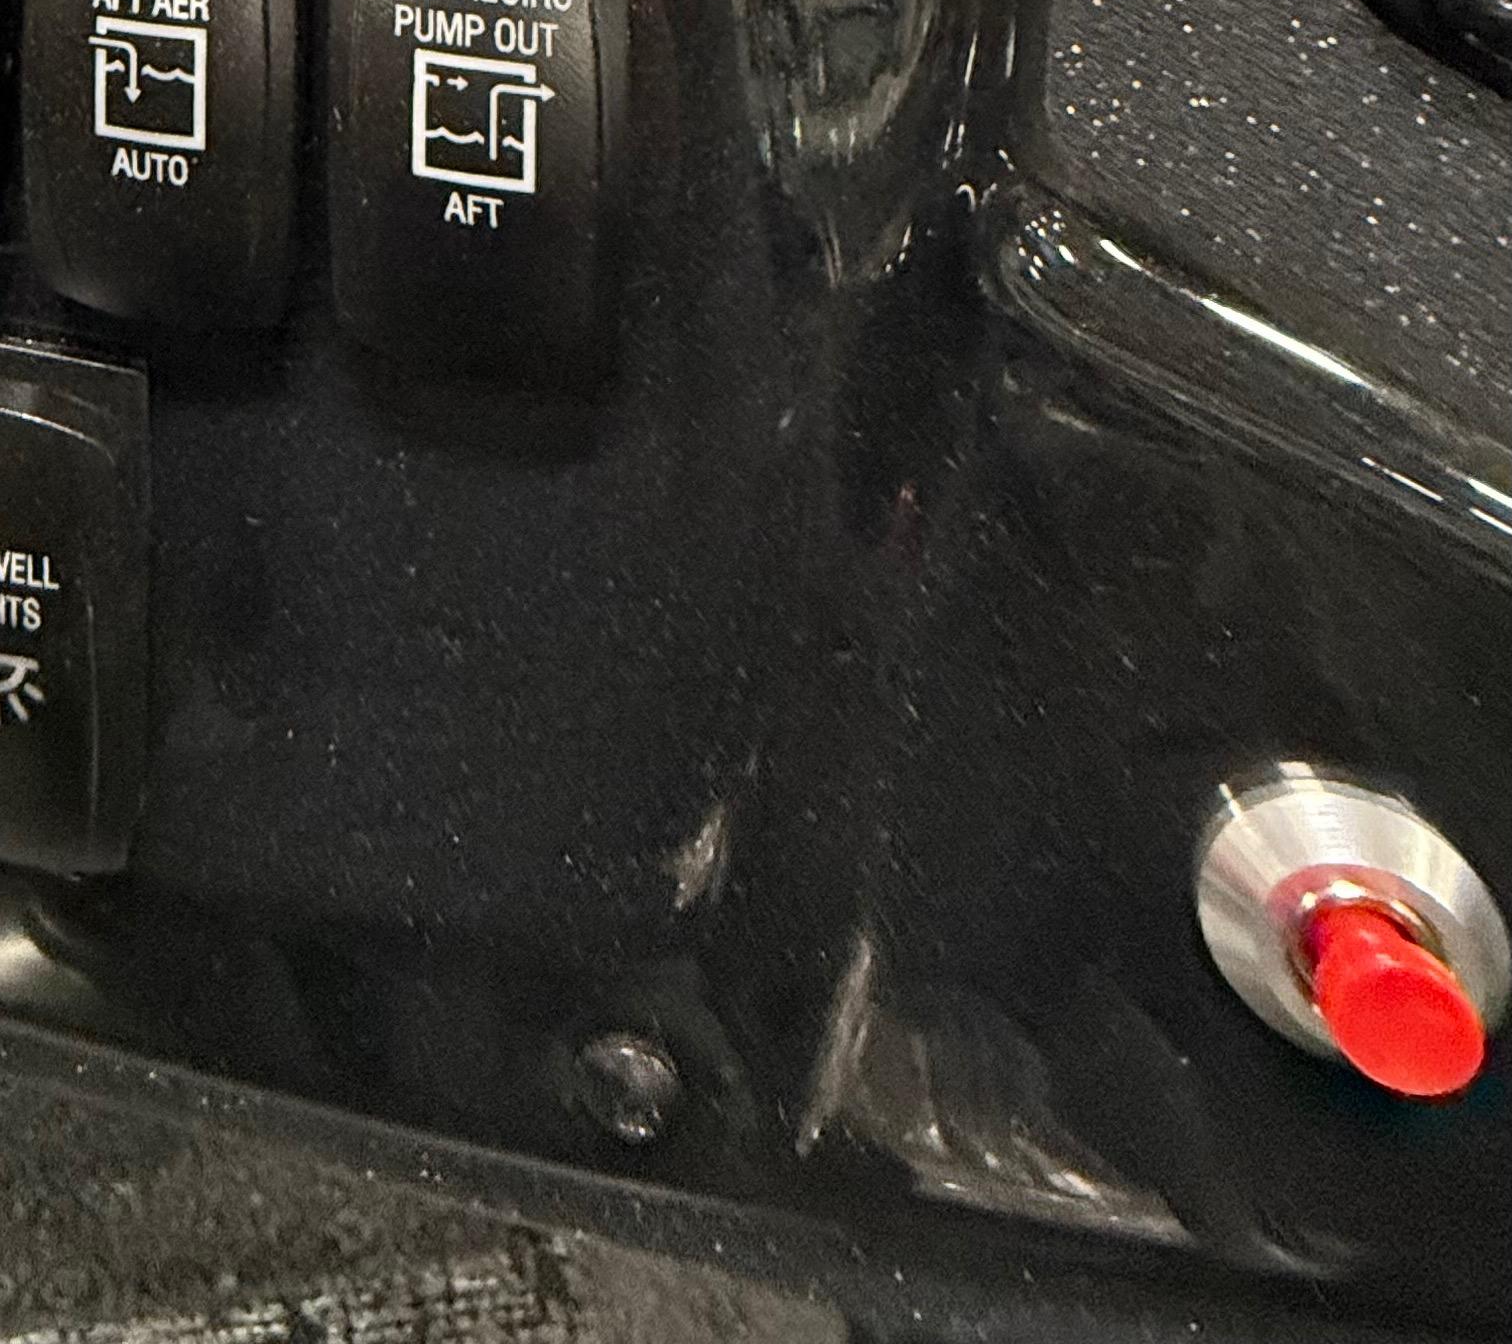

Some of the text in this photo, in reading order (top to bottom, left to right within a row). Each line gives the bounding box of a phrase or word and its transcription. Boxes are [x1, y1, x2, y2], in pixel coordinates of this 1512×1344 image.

[393, 4, 560, 57] PUMP OUT
[111, 147, 189, 187] AUTO
[444, 190, 505, 229] AFT
